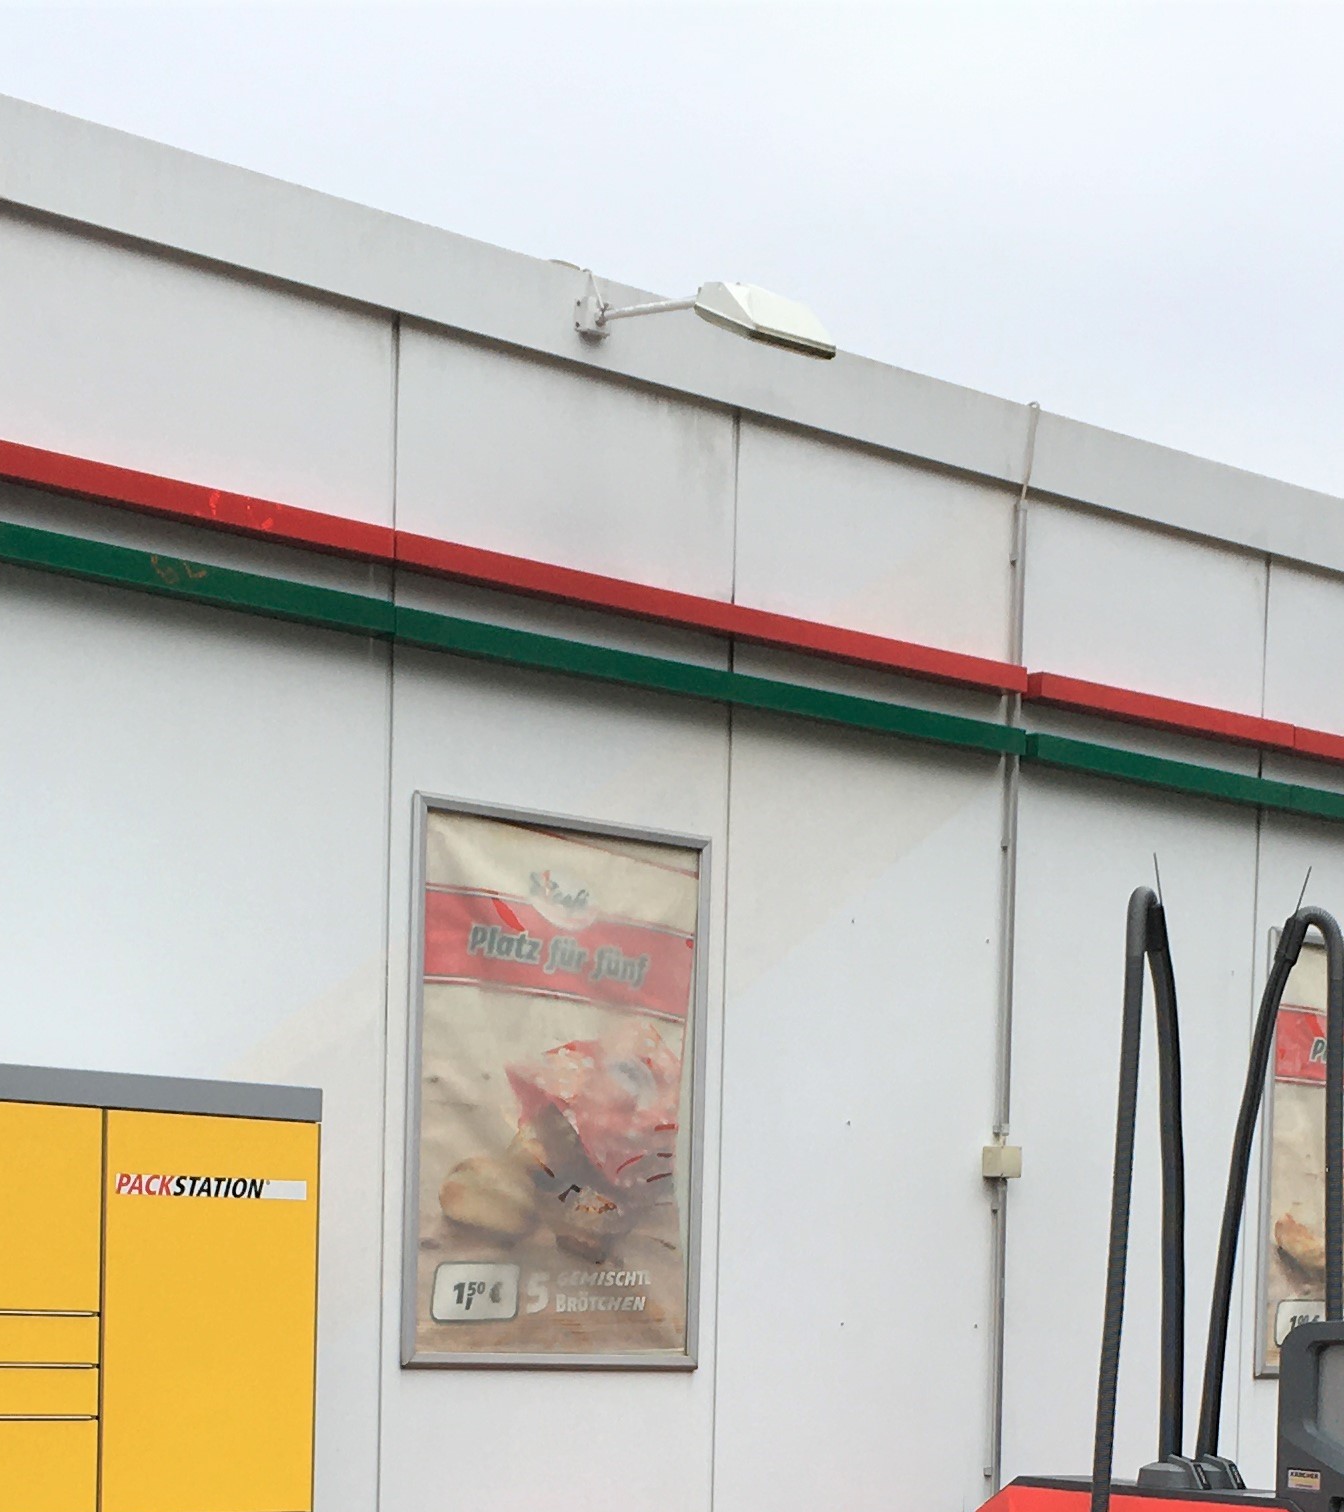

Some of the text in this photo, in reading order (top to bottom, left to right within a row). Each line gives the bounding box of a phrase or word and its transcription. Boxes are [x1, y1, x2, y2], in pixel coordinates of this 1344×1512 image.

[469, 925, 650, 988] Platz für fünf
[115, 1173, 265, 1199] PACKSTATION
[526, 1271, 550, 1314] 5
[556, 1291, 646, 1313] BRÖTCHEN
